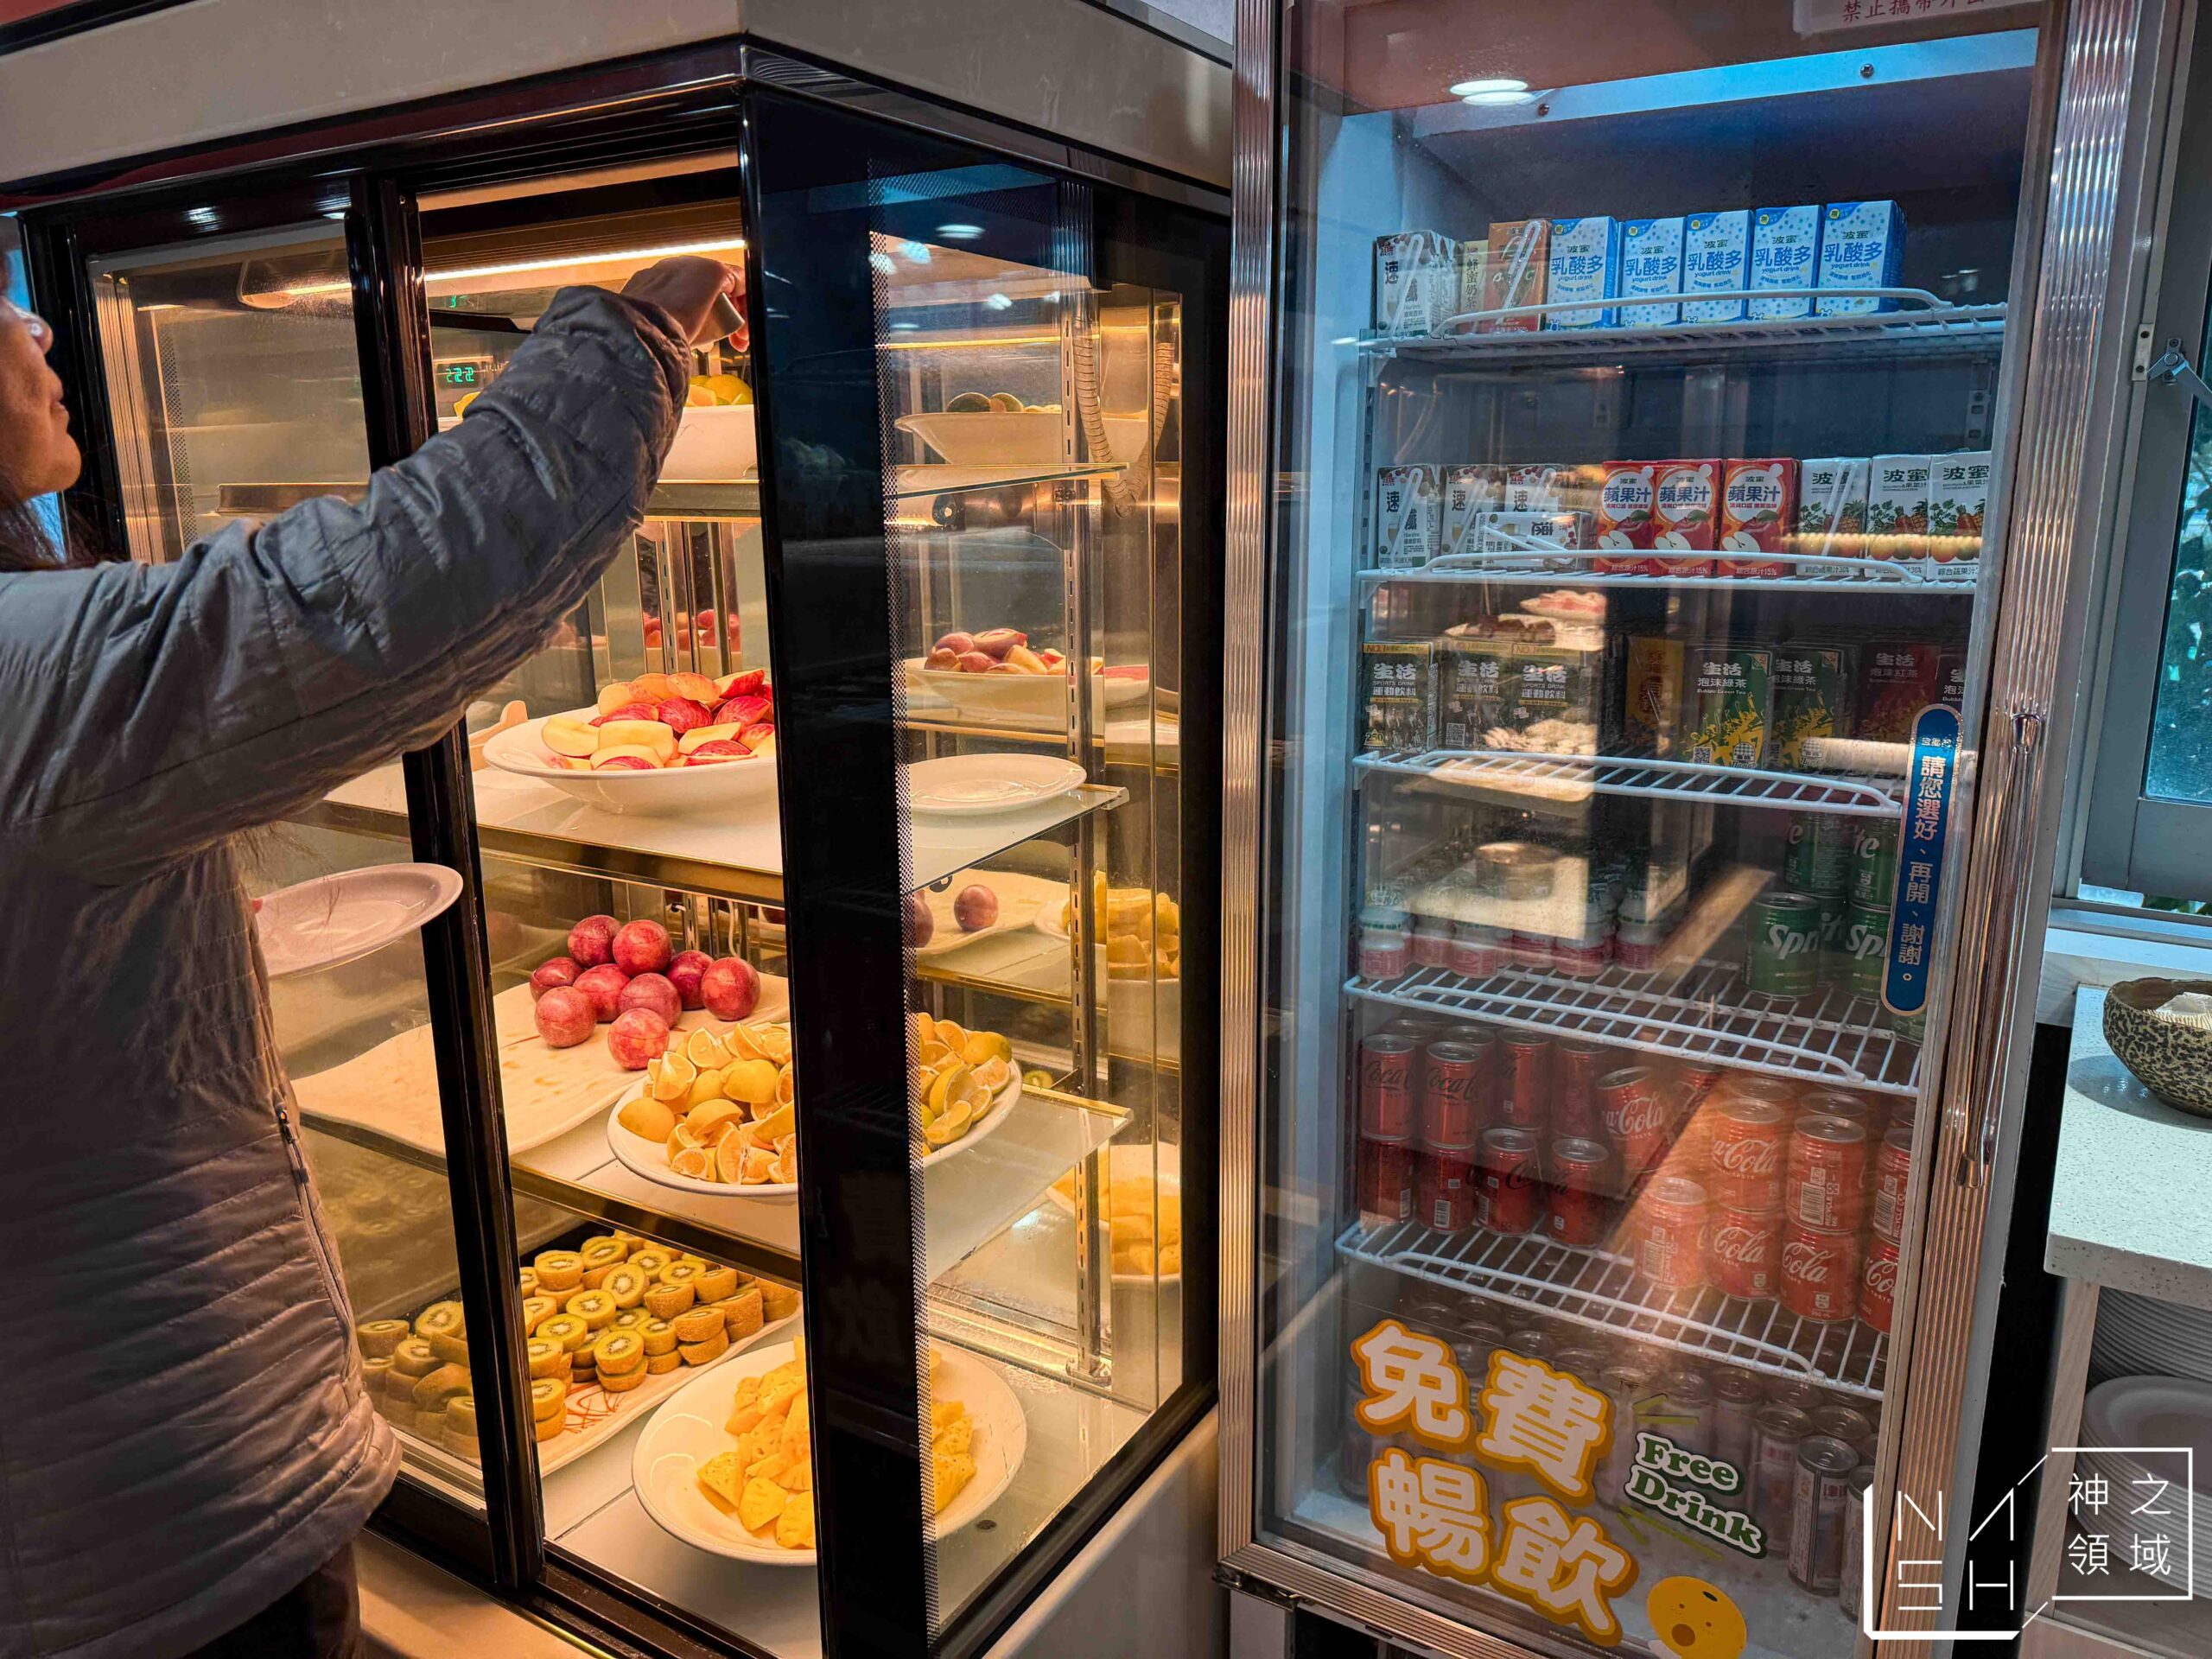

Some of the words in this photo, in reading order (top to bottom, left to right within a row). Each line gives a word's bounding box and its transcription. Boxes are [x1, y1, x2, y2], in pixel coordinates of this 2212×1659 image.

[1772, 235, 1796, 244] 波蜜
[1842, 230, 1868, 239] 波蜜
[1642, 245, 1664, 254] 波蜜
[1705, 238, 1728, 248] 波蜜
[1688, 250, 1742, 270] 乳酸多
[1755, 245, 1811, 267] 乳酸多
[1824, 241, 1882, 263] 乳酸多
[1552, 256, 1603, 275] 乳酸多
[1625, 256, 1677, 276] 乳酸多
[1884, 469, 1928, 482] 波蜜
[1943, 466, 1989, 480] 波蜜
[1452, 490, 1466, 512] 速
[1514, 490, 1528, 512] 速
[1604, 486, 1651, 502] 蘋果汁
[1659, 486, 1710, 502] 蘋果汁
[1728, 485, 1781, 501] 蘋果汁
[1387, 491, 1400, 512] 速
[1776, 659, 1813, 673] 生活
[1875, 653, 1915, 666] 生活
[1373, 664, 1416, 680] 生活
[1523, 664, 1567, 683] 生活
[1702, 662, 1742, 676] 生活
[1698, 677, 1747, 688] 泡沫綠茶
[1372, 687, 1416, 696] 運動飲料
[1521, 689, 1567, 700] 運動飲料
[1355, 1322, 1610, 1500] 免費
[1637, 1433, 1737, 1490] Free
[1628, 1466, 1759, 1552] Drink
[1372, 1452, 1633, 1638] 暢飲
